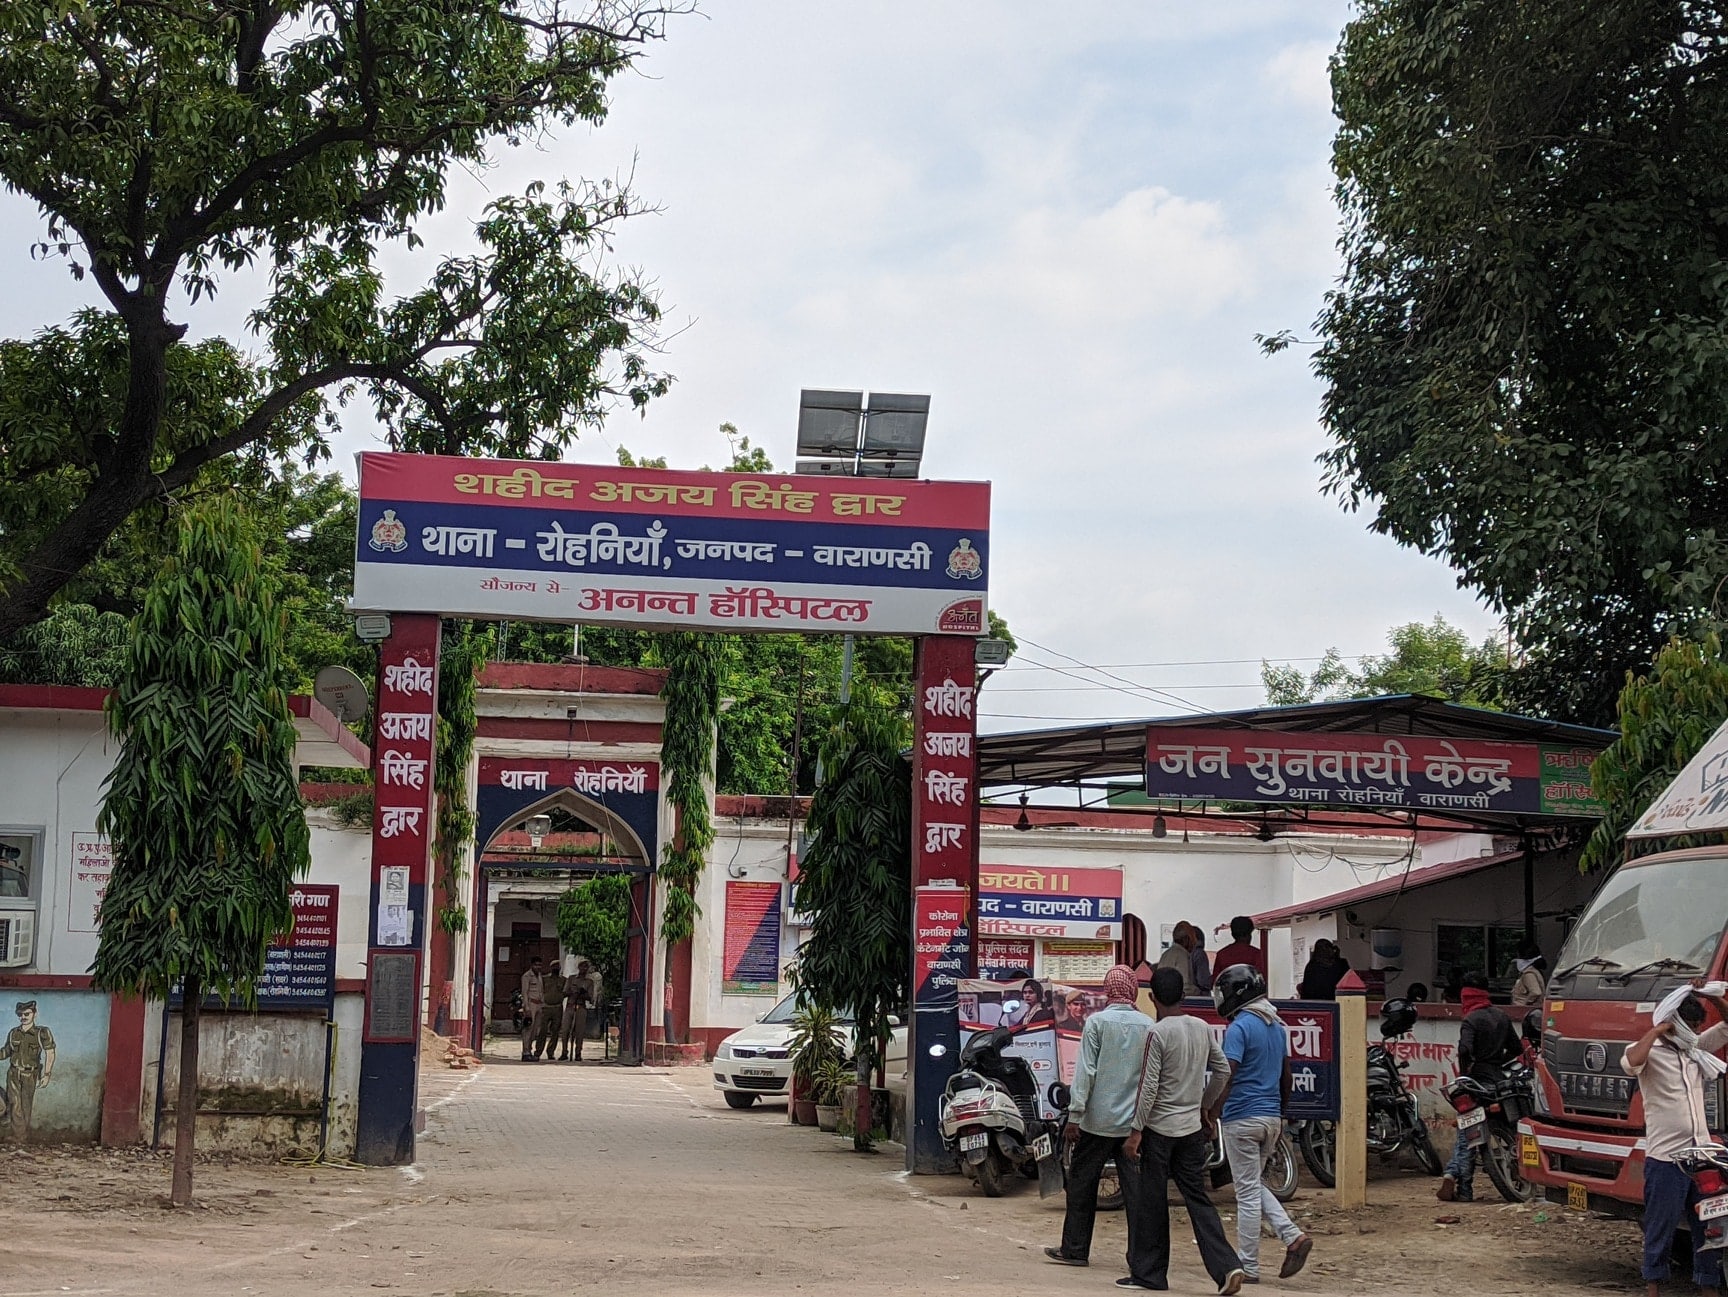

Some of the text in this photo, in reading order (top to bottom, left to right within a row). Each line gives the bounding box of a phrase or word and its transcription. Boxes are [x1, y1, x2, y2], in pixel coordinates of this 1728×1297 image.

[454, 468, 906, 516] शहीद अजय सिंह द्वार
[421, 526, 497, 558] थाना
[674, 539, 778, 564] जनपद
[812, 541, 932, 570] वाराणसी
[479, 576, 537, 593] सौजन्य
[577, 588, 699, 615] अनन्त
[708, 586, 872, 623] हॉस्पिटल
[383, 657, 433, 697] शहीद
[924, 678, 973, 720] शहीद
[379, 712, 432, 741] अजय
[924, 732, 972, 758] अजय
[380, 749, 428, 790] सिंह
[500, 770, 549, 791] थाना
[1157, 739, 1513, 796] जन सुनवायी केन्द्र
[925, 769, 968, 806] सिंह
[1288, 787, 1331, 801] थाना
[1417, 791, 1490, 809] वाराणसी
[380, 806, 424, 838] द्वार
[925, 823, 967, 853] द्वार
[979, 870, 1046, 890] जयते
[929, 910, 958, 920] कोरोना
[1021, 898, 1093, 917] वाराणसी
[919, 925, 968, 938] प्रभावित क्षेत्र
[985, 941, 1007, 957] पुलिस
[927, 958, 961, 970] वाराणसी
[1560, 1074, 1629, 1099] EICHER
